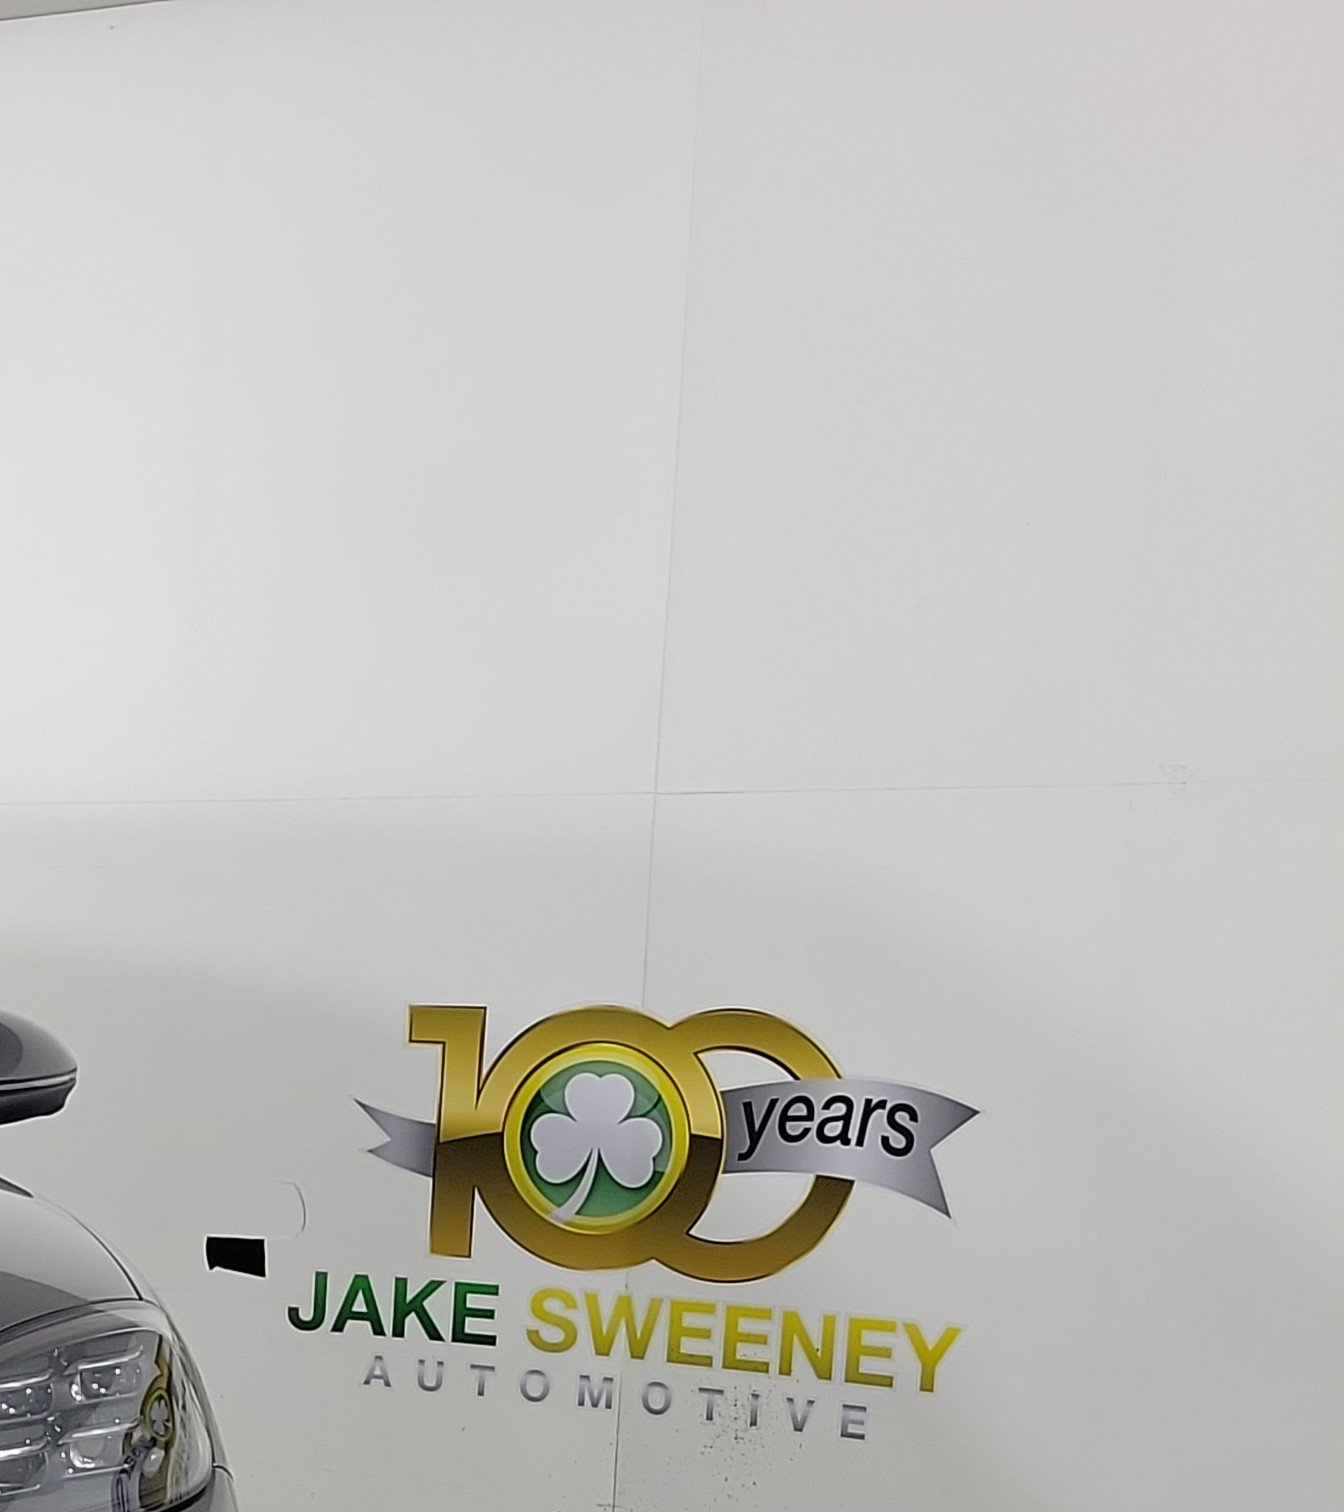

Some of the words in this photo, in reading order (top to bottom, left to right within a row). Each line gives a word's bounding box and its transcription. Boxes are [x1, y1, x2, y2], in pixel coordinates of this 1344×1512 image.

[408, 1005, 856, 1283] 100
[737, 1093, 920, 1160] years
[288, 1272, 500, 1346] JAKE
[527, 1286, 960, 1392] SWEENEY
[363, 1355, 867, 1440] AUTOMOTIVE
